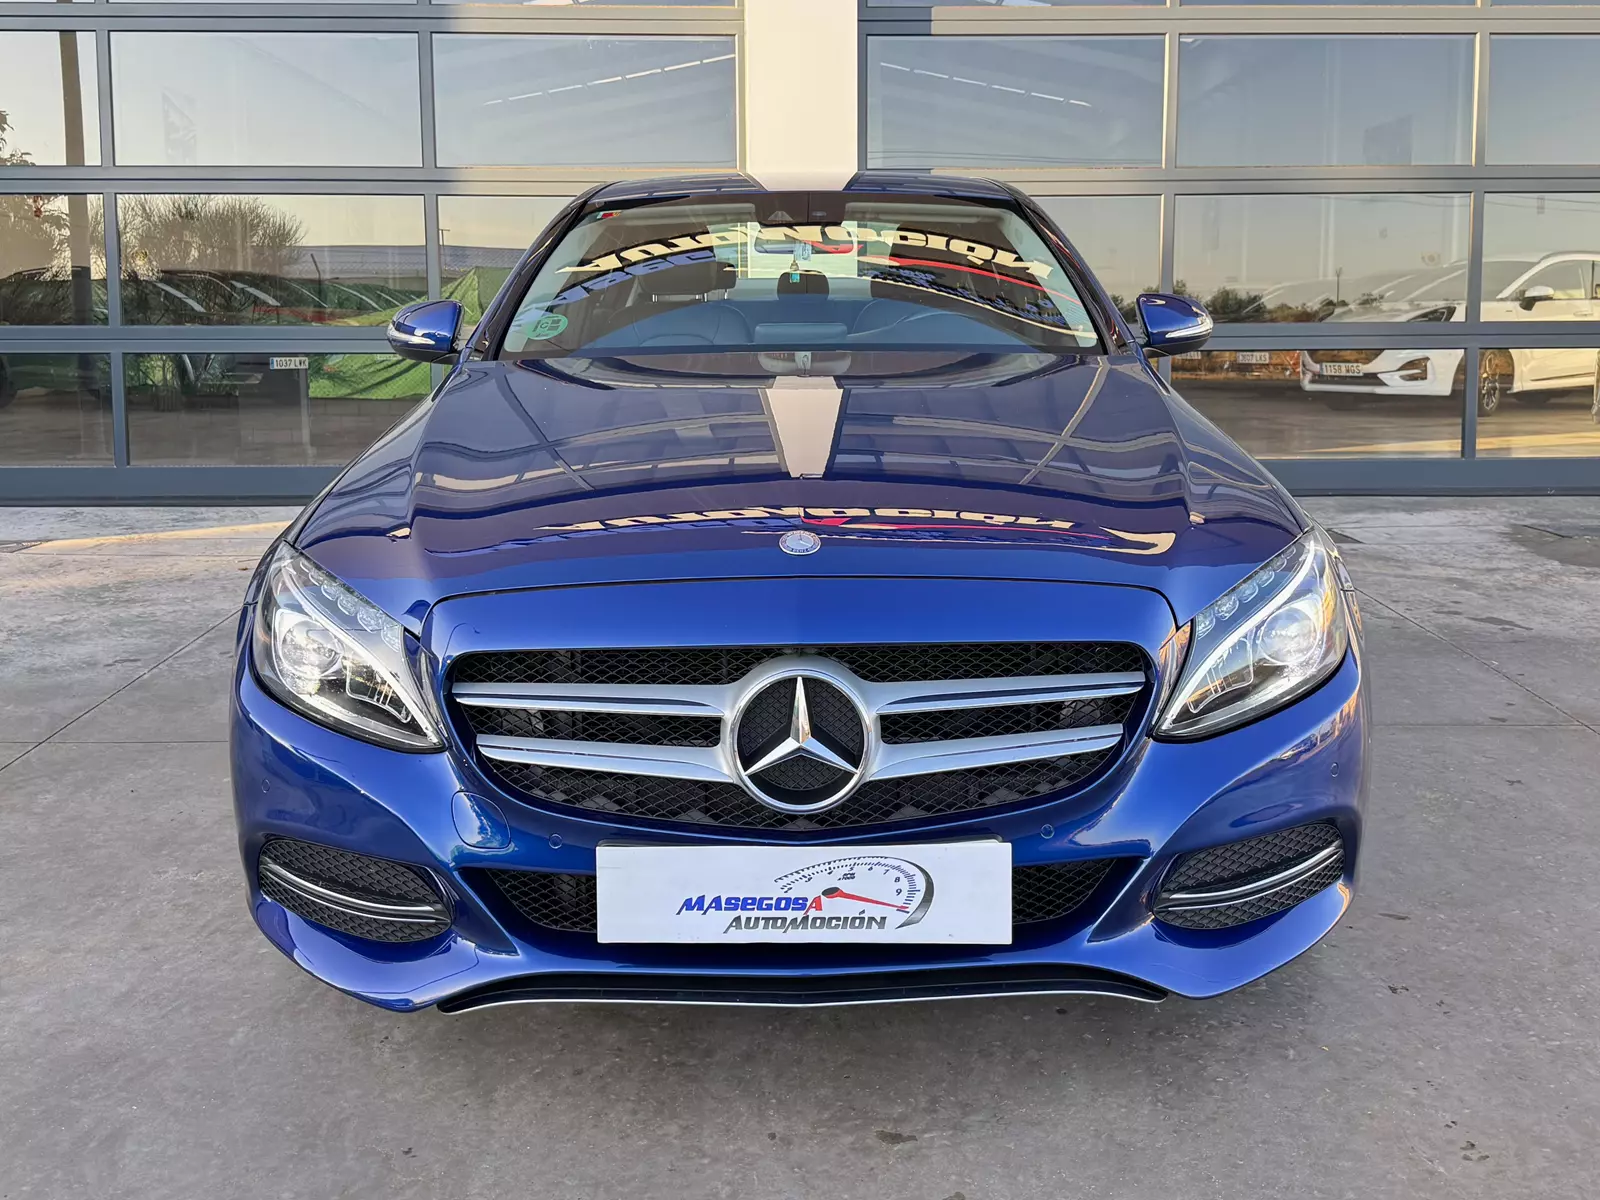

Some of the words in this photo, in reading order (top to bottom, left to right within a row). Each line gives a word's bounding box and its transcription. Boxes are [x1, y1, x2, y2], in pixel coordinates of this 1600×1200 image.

[275, 359, 293, 368] 1037
[1324, 364, 1342, 374] 1158
[895, 888, 903, 897] 9
[676, 895, 823, 916] MASEGOSA
[723, 909, 887, 934] AUTOMOCIÓN
